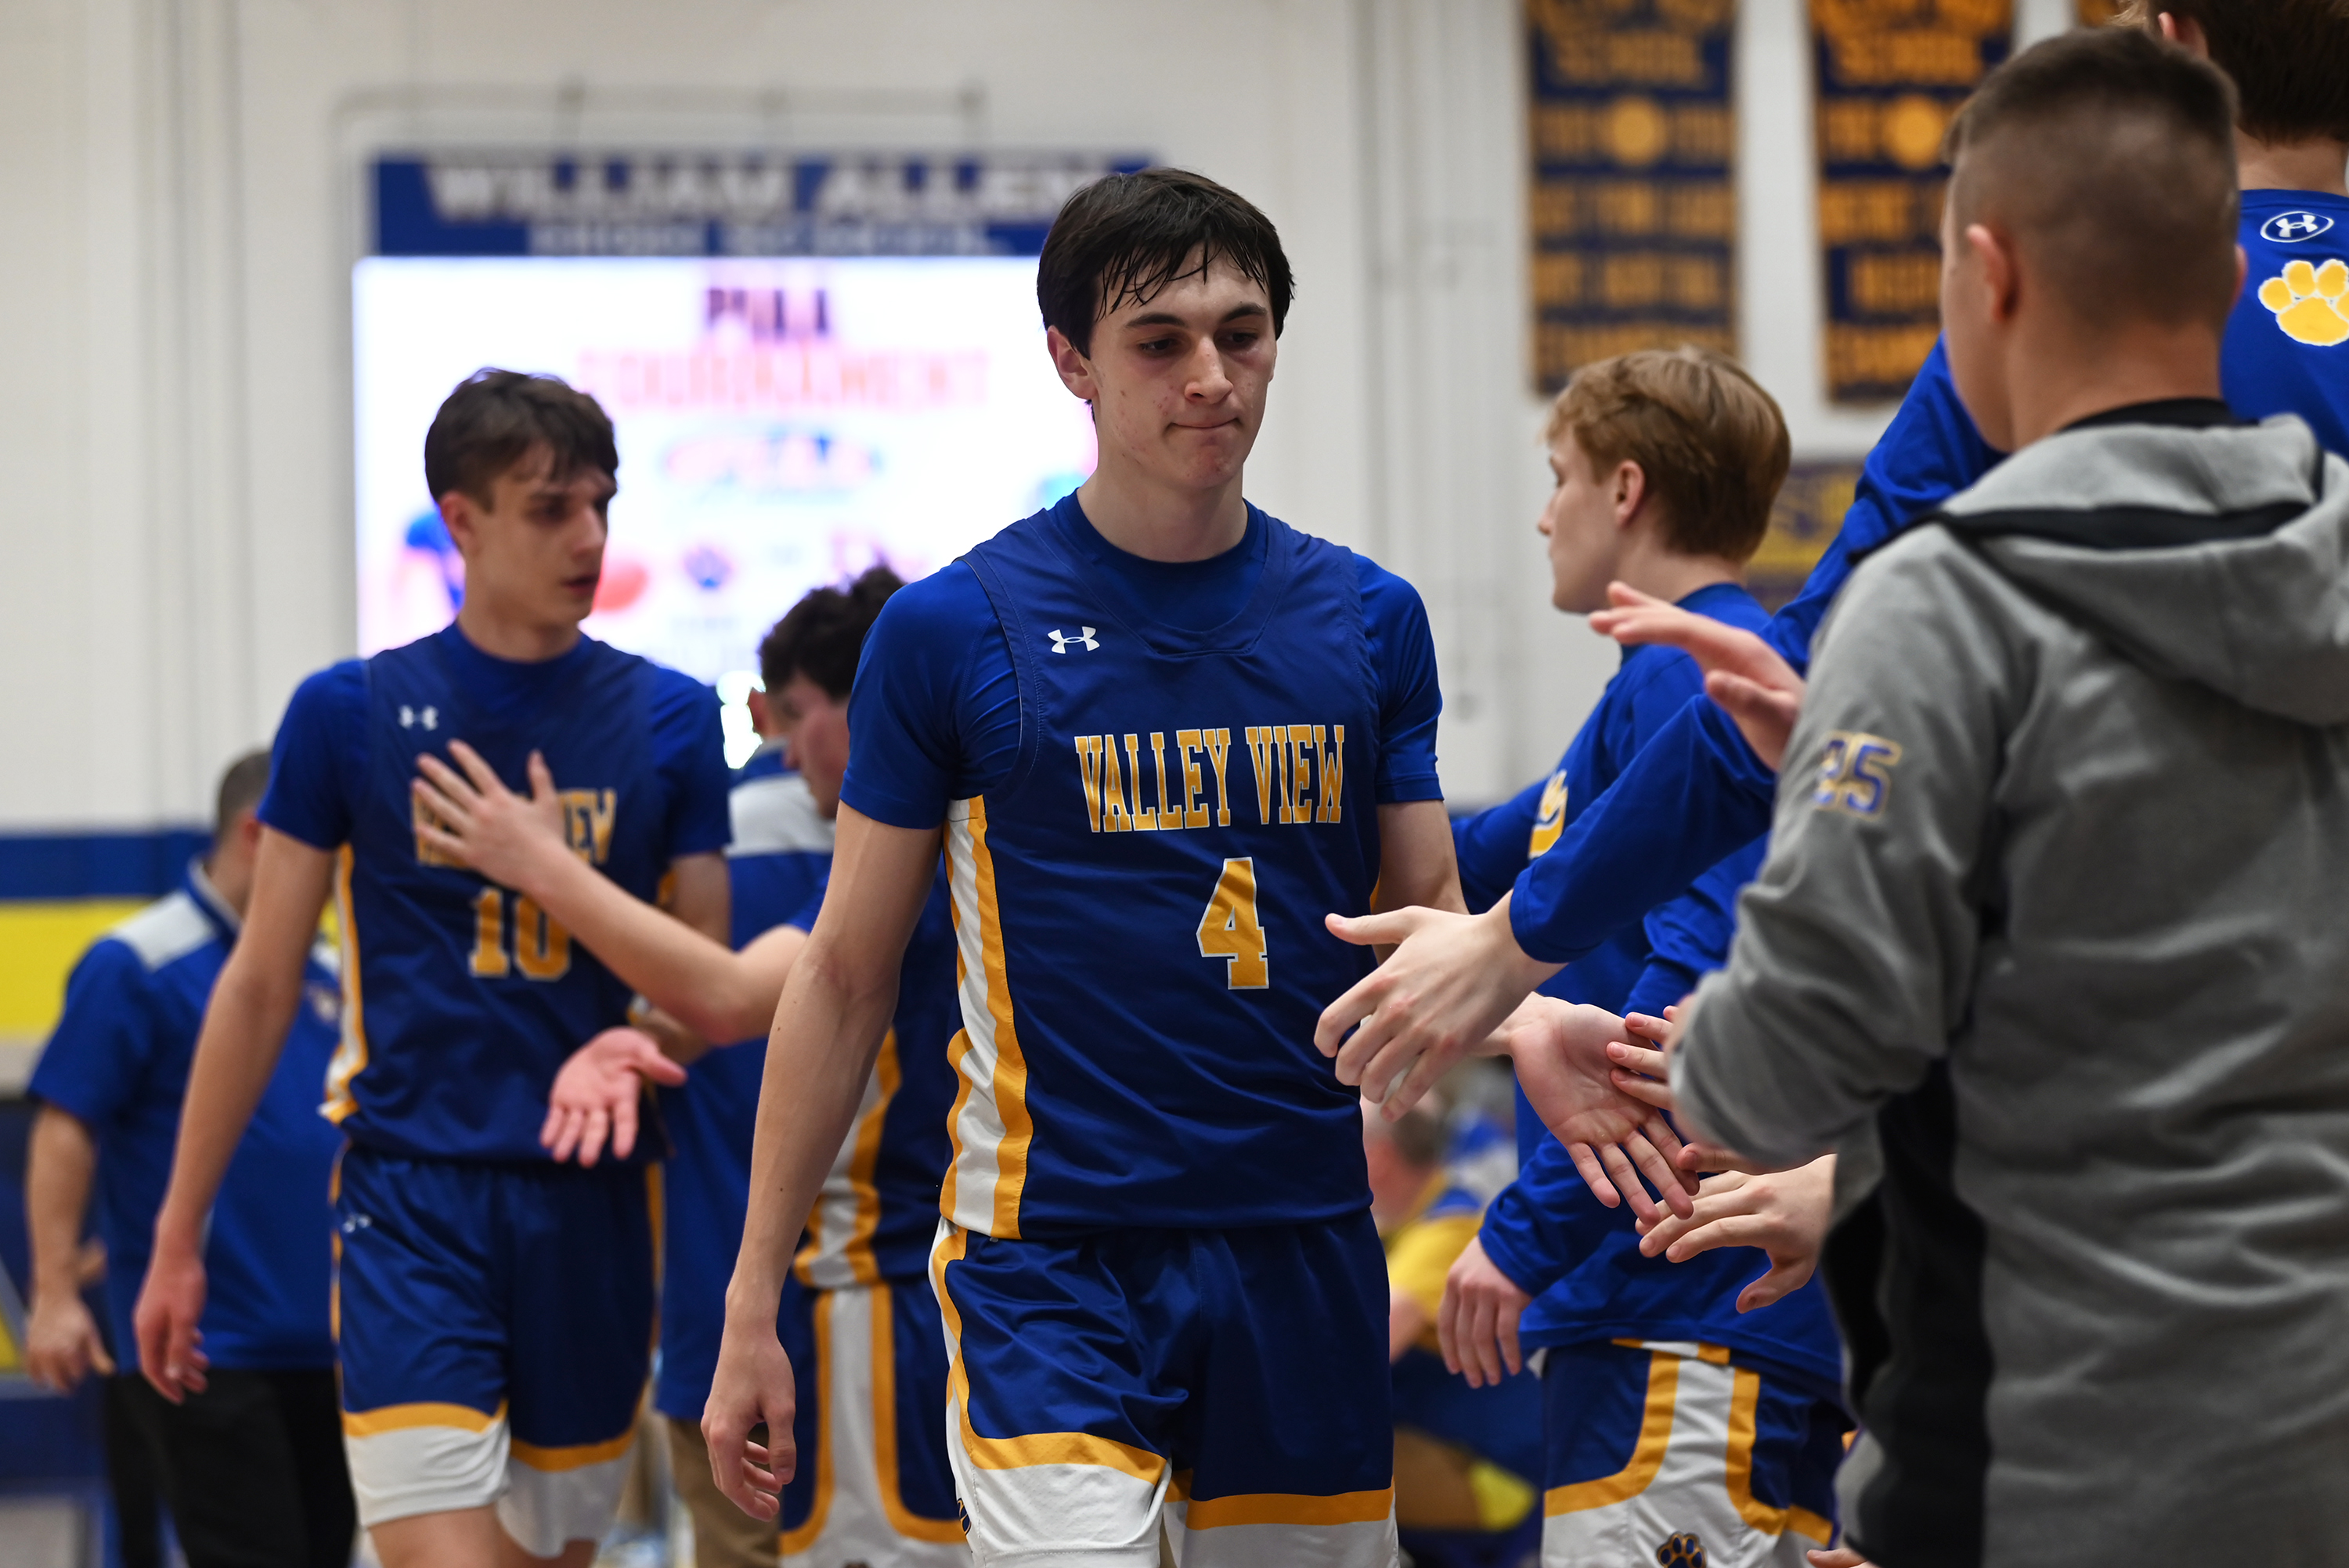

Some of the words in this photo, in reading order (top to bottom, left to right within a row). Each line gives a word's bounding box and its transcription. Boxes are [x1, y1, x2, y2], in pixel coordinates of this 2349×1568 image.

[1073, 726, 1232, 833] VALLEY
[1244, 724, 1344, 825] VIEW
[470, 886, 572, 982] 10
[1195, 856, 1269, 990] 4
